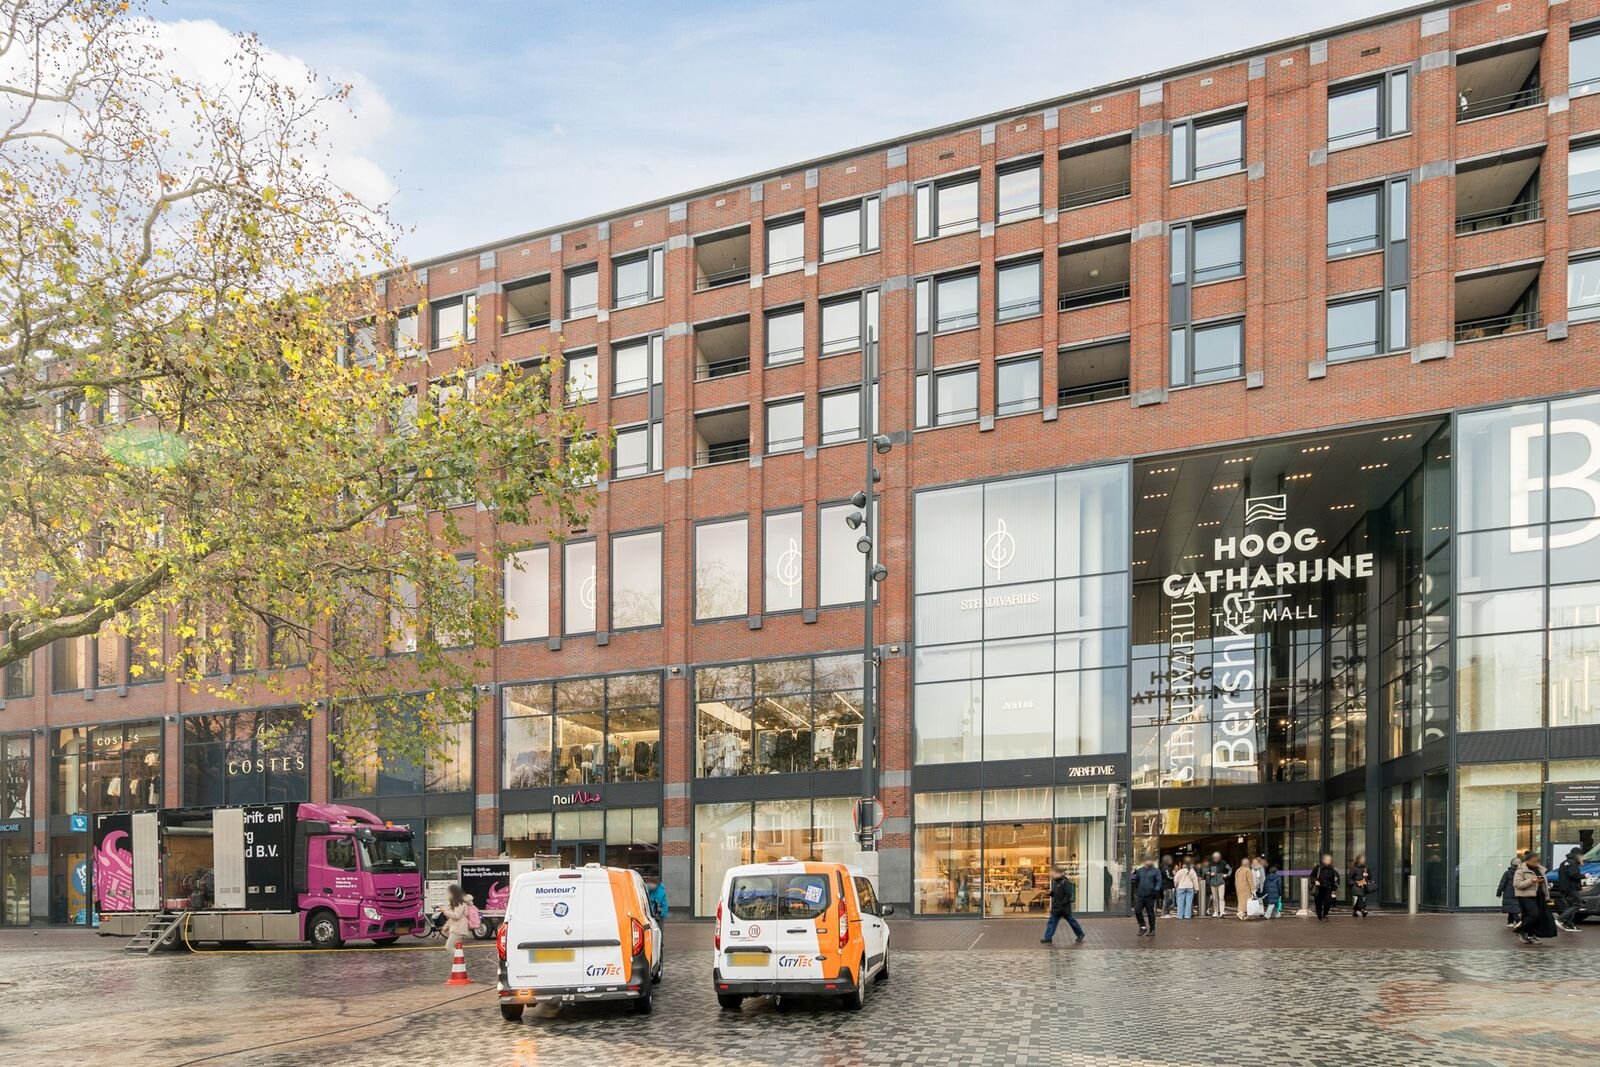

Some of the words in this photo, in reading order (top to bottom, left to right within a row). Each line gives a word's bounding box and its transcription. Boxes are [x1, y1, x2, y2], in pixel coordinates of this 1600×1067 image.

[1213, 528, 1319, 561] HOOG
[1162, 552, 1374, 598] CATHARIJNE
[960, 592, 1040, 612] STRADIVARIUS
[1211, 611, 1252, 627] THE
[1262, 604, 1319, 622] MALL
[1212, 590, 1255, 768] Bershka
[228, 756, 305, 775] COSTES
[267, 813, 281, 823] en
[256, 844, 279, 858] B.V.
[535, 886, 577, 895] Monteur?
